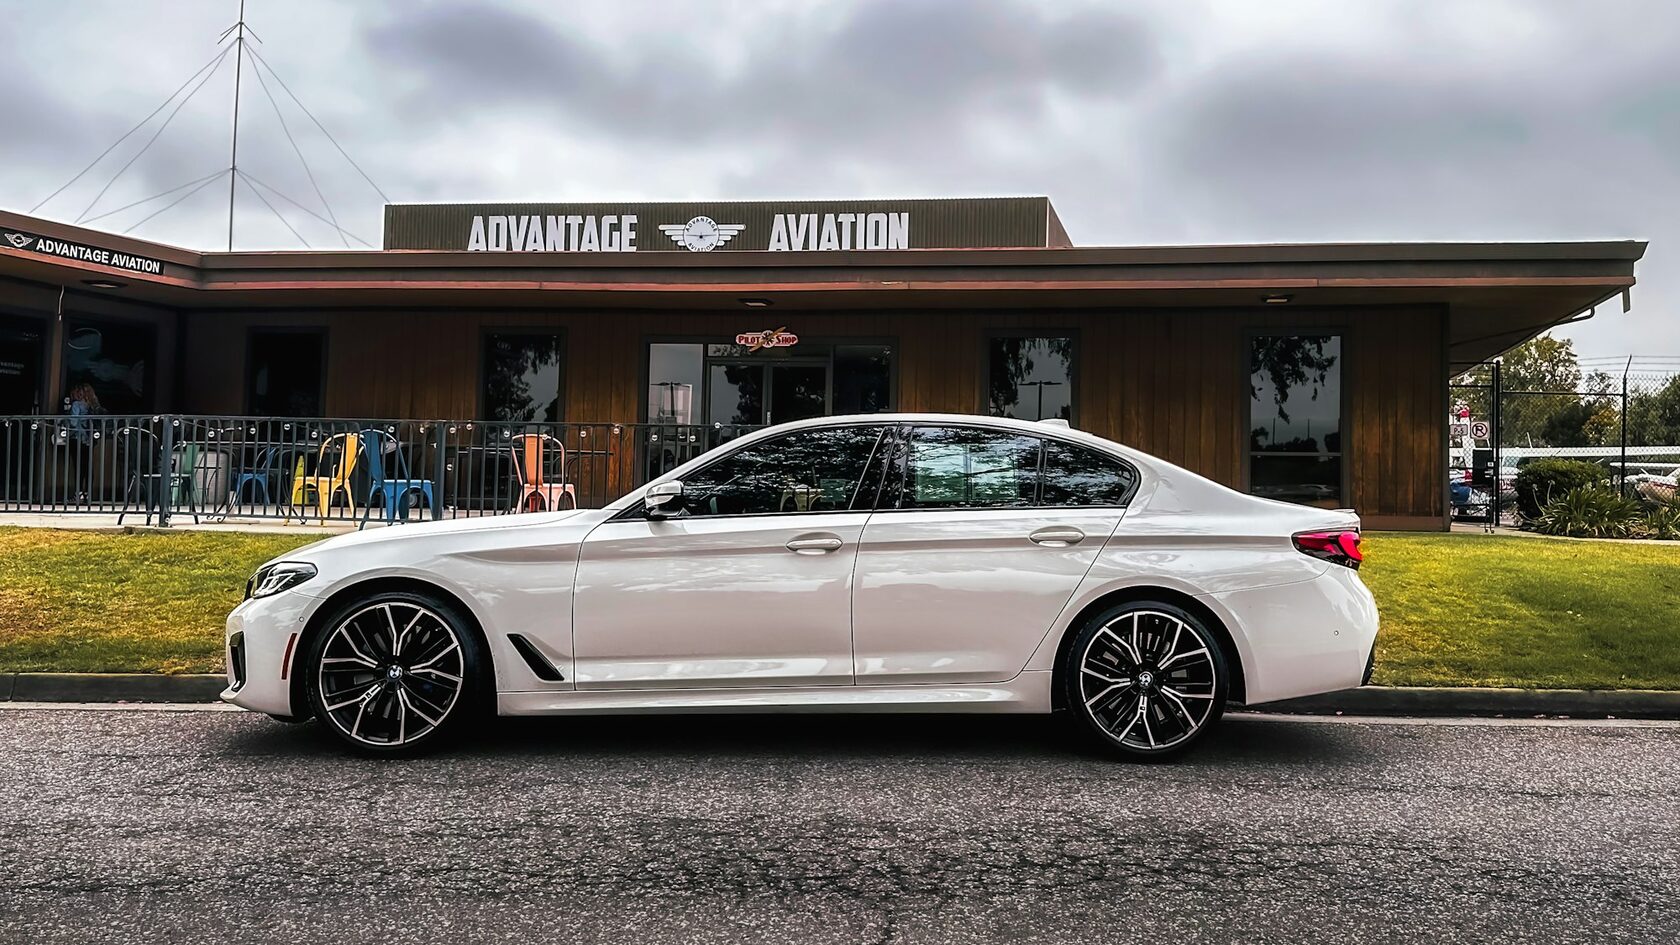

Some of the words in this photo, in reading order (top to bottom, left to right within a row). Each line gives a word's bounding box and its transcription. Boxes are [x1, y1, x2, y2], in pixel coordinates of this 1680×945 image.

[467, 215, 638, 252] ADVANTAGE
[768, 212, 909, 251] AVIATION
[685, 217, 718, 233] ADVANTAGE
[688, 242, 715, 252] AVIATION
[36, 238, 109, 264] ADVANTAGE
[110, 254, 160, 273] AVIATION
[738, 335, 760, 344] PILOT
[776, 335, 797, 344] SHOP
